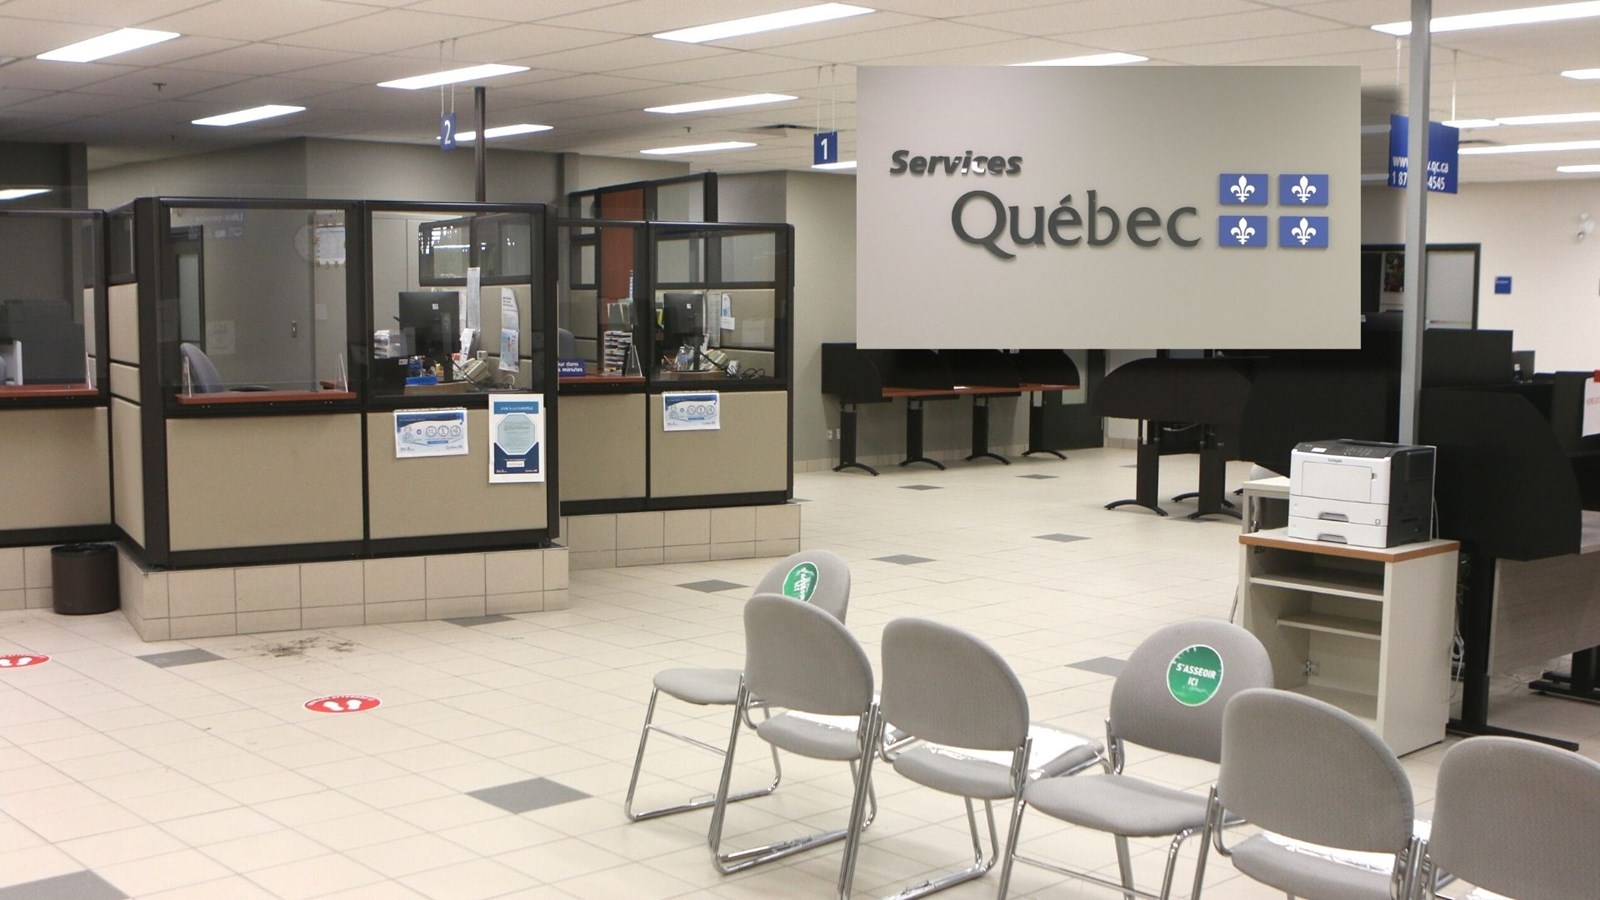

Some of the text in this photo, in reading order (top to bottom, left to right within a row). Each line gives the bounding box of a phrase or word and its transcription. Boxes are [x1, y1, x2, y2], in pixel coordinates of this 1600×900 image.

[444, 119, 451, 145] 2
[820, 138, 828, 160] 1
[889, 149, 1023, 175] Services
[951, 189, 1202, 260] Québec
[1176, 663, 1217, 679] S'ASSEOIR
[1187, 677, 1199, 687] ICI
